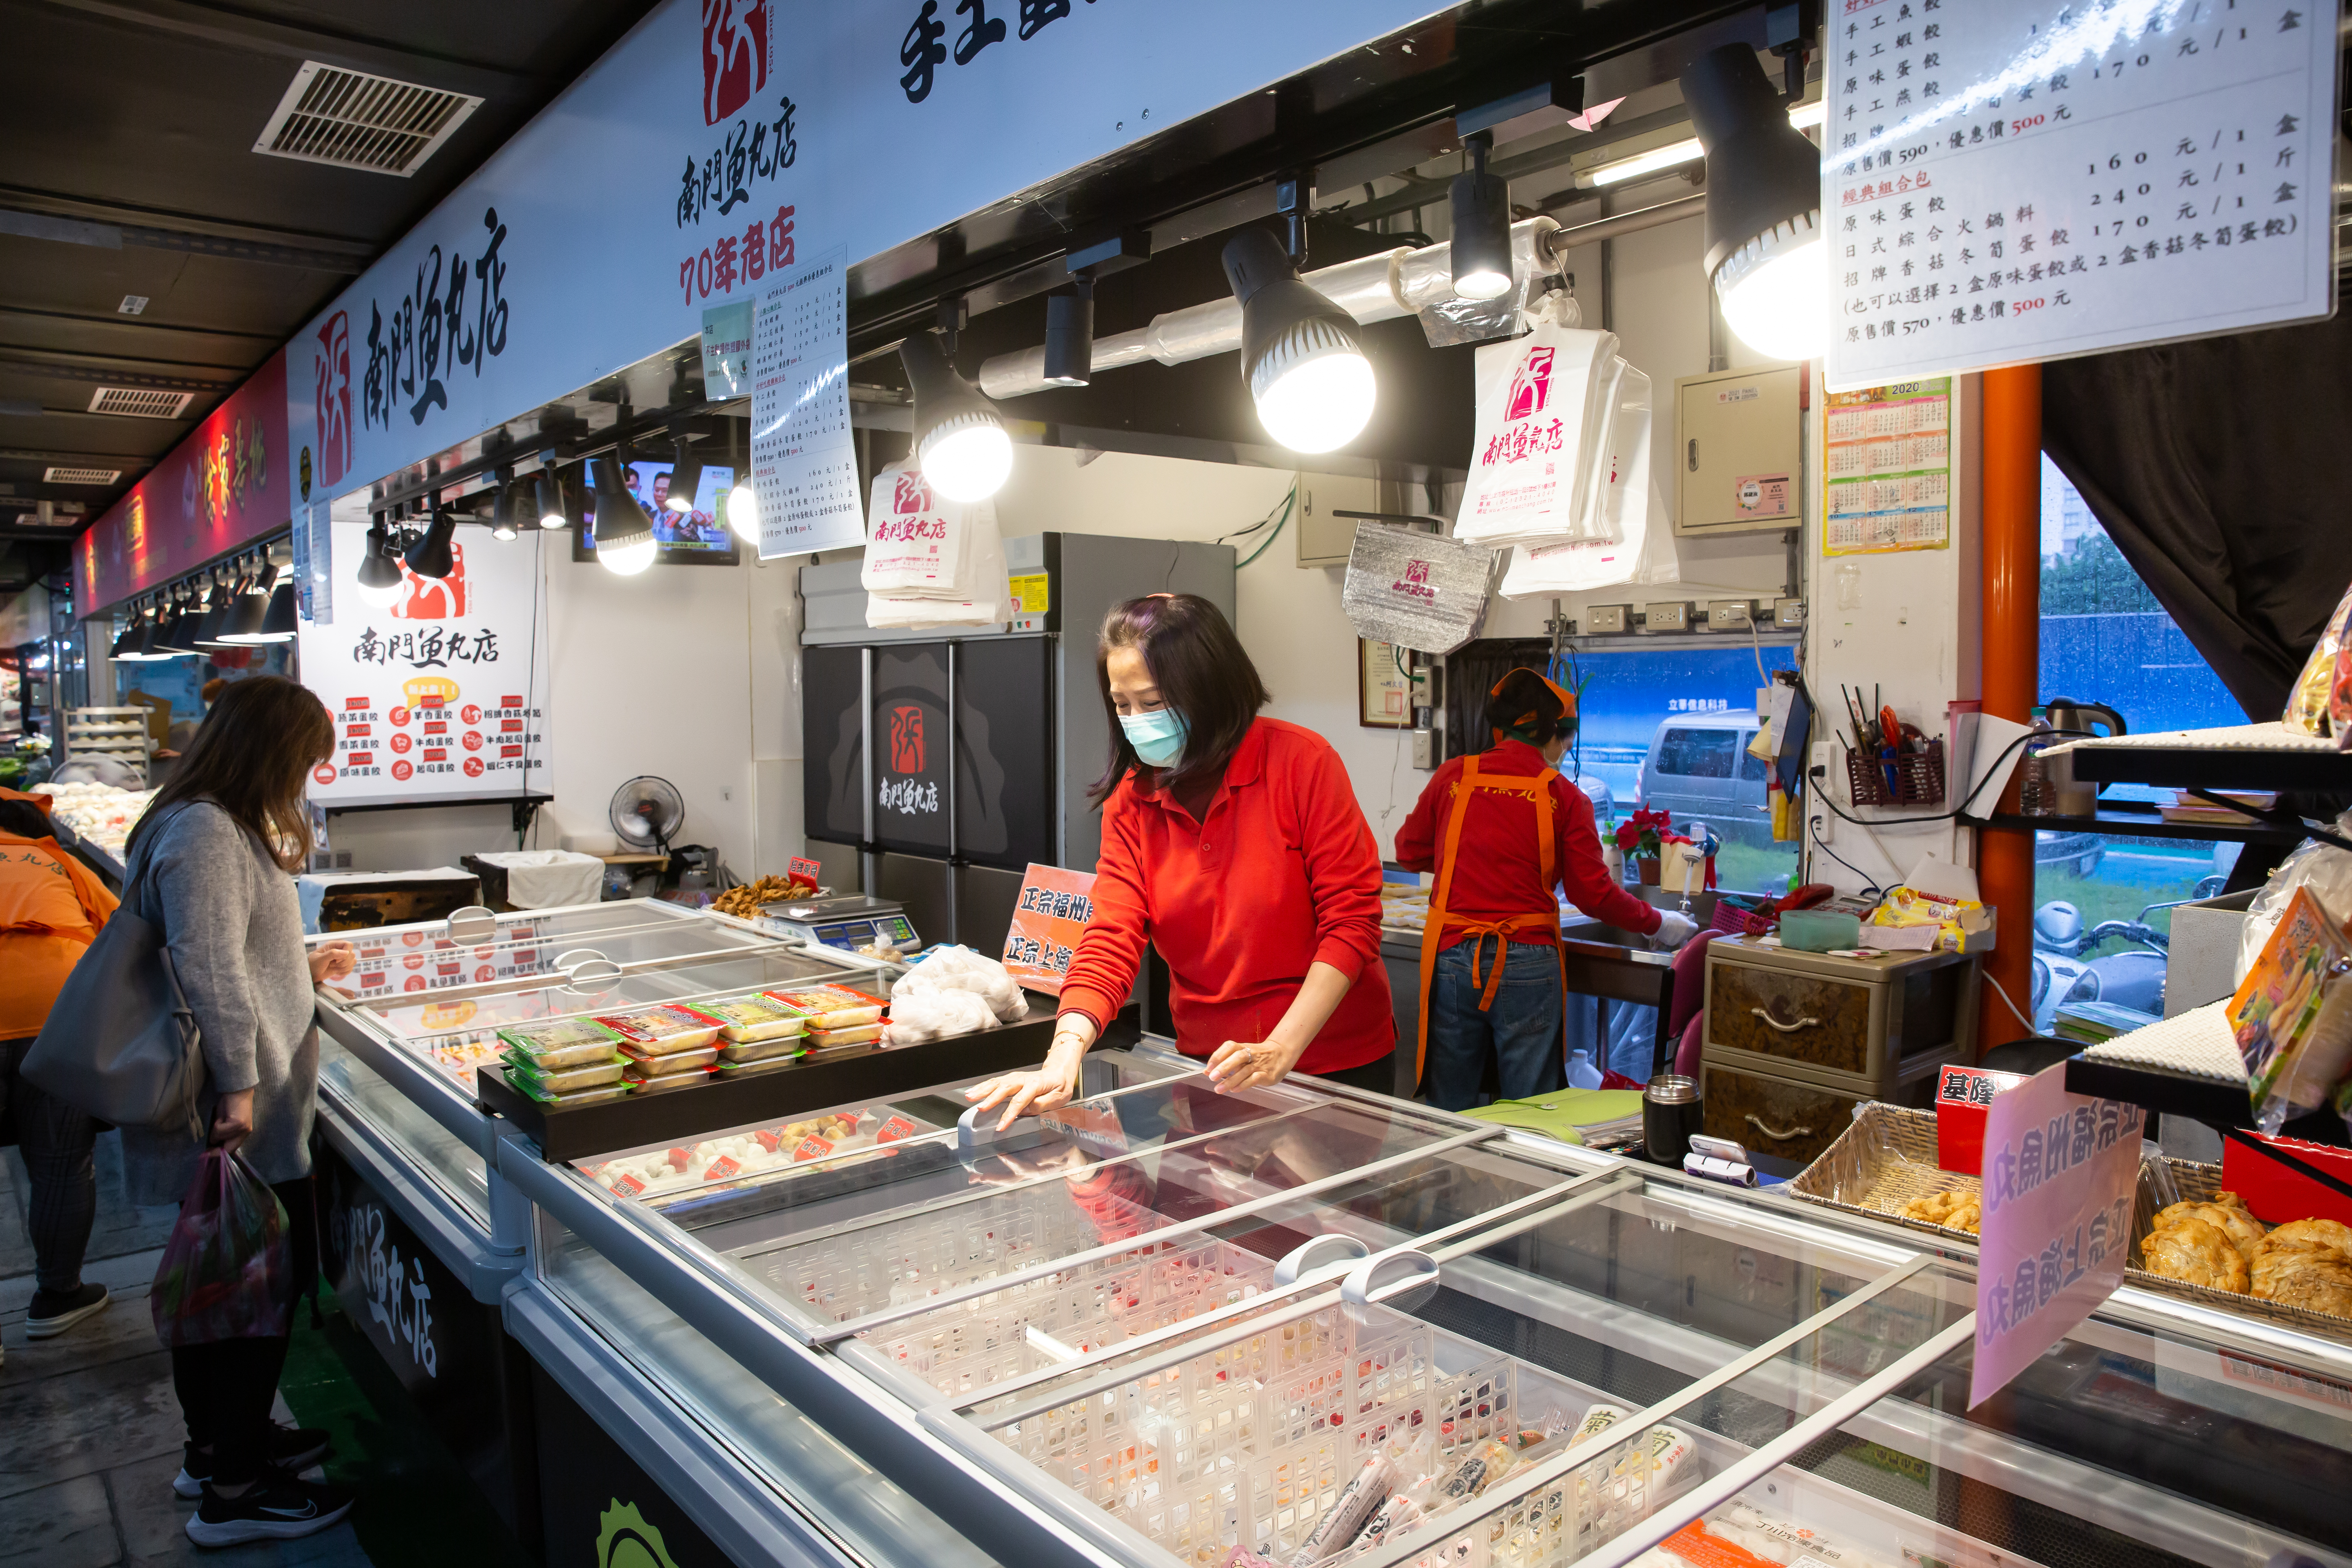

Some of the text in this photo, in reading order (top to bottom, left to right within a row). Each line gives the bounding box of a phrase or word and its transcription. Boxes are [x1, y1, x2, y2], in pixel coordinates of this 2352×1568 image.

[1843, 52, 1940, 94] 原味蛋餃
[677, 96, 797, 229] 南門魚丸店
[1842, 170, 1932, 205] 經典組合包
[1843, 196, 1946, 232] 原味蛋餃
[1845, 205, 2035, 259] 日式綜合火鍋料
[679, 205, 795, 307] 70年老店
[1843, 228, 2070, 289] 招牌香菇冬筍蛋餃
[364, 207, 509, 432] 南門魚丸店
[705, 325, 713, 335] 本店
[1892, 382, 1920, 395] 2020
[875, 516, 947, 542] 南門魚丸店
[354, 626, 499, 668] 南門魚丸店
[879, 777, 938, 814] 南門魚丸店
[1942, 1072, 1998, 1106] 基隆
